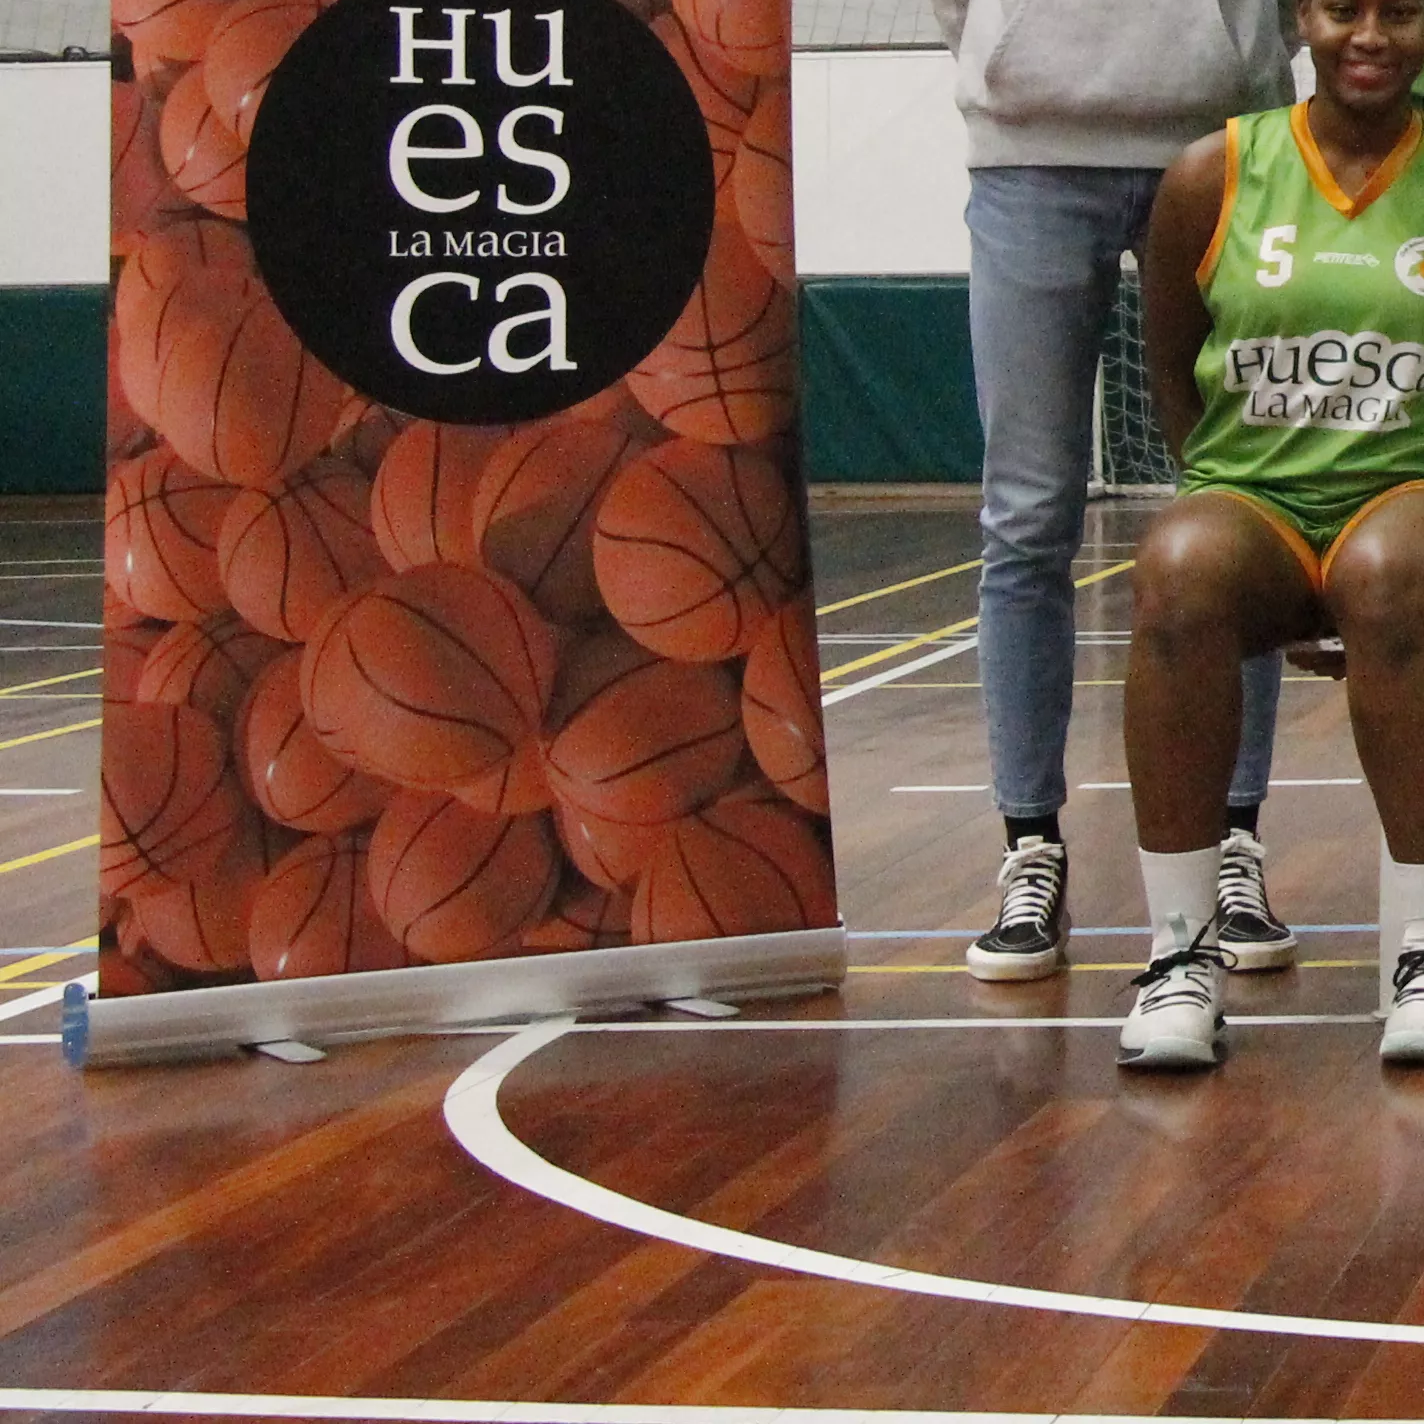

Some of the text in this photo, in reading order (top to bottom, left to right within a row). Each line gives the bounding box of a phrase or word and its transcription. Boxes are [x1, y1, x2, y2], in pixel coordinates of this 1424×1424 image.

[389, 6, 573, 87] Hu
[389, 103, 571, 215] es
[389, 230, 432, 257] La
[1256, 225, 1297, 287] 5
[390, 272, 577, 375] ca
[1251, 391, 1290, 419] La
